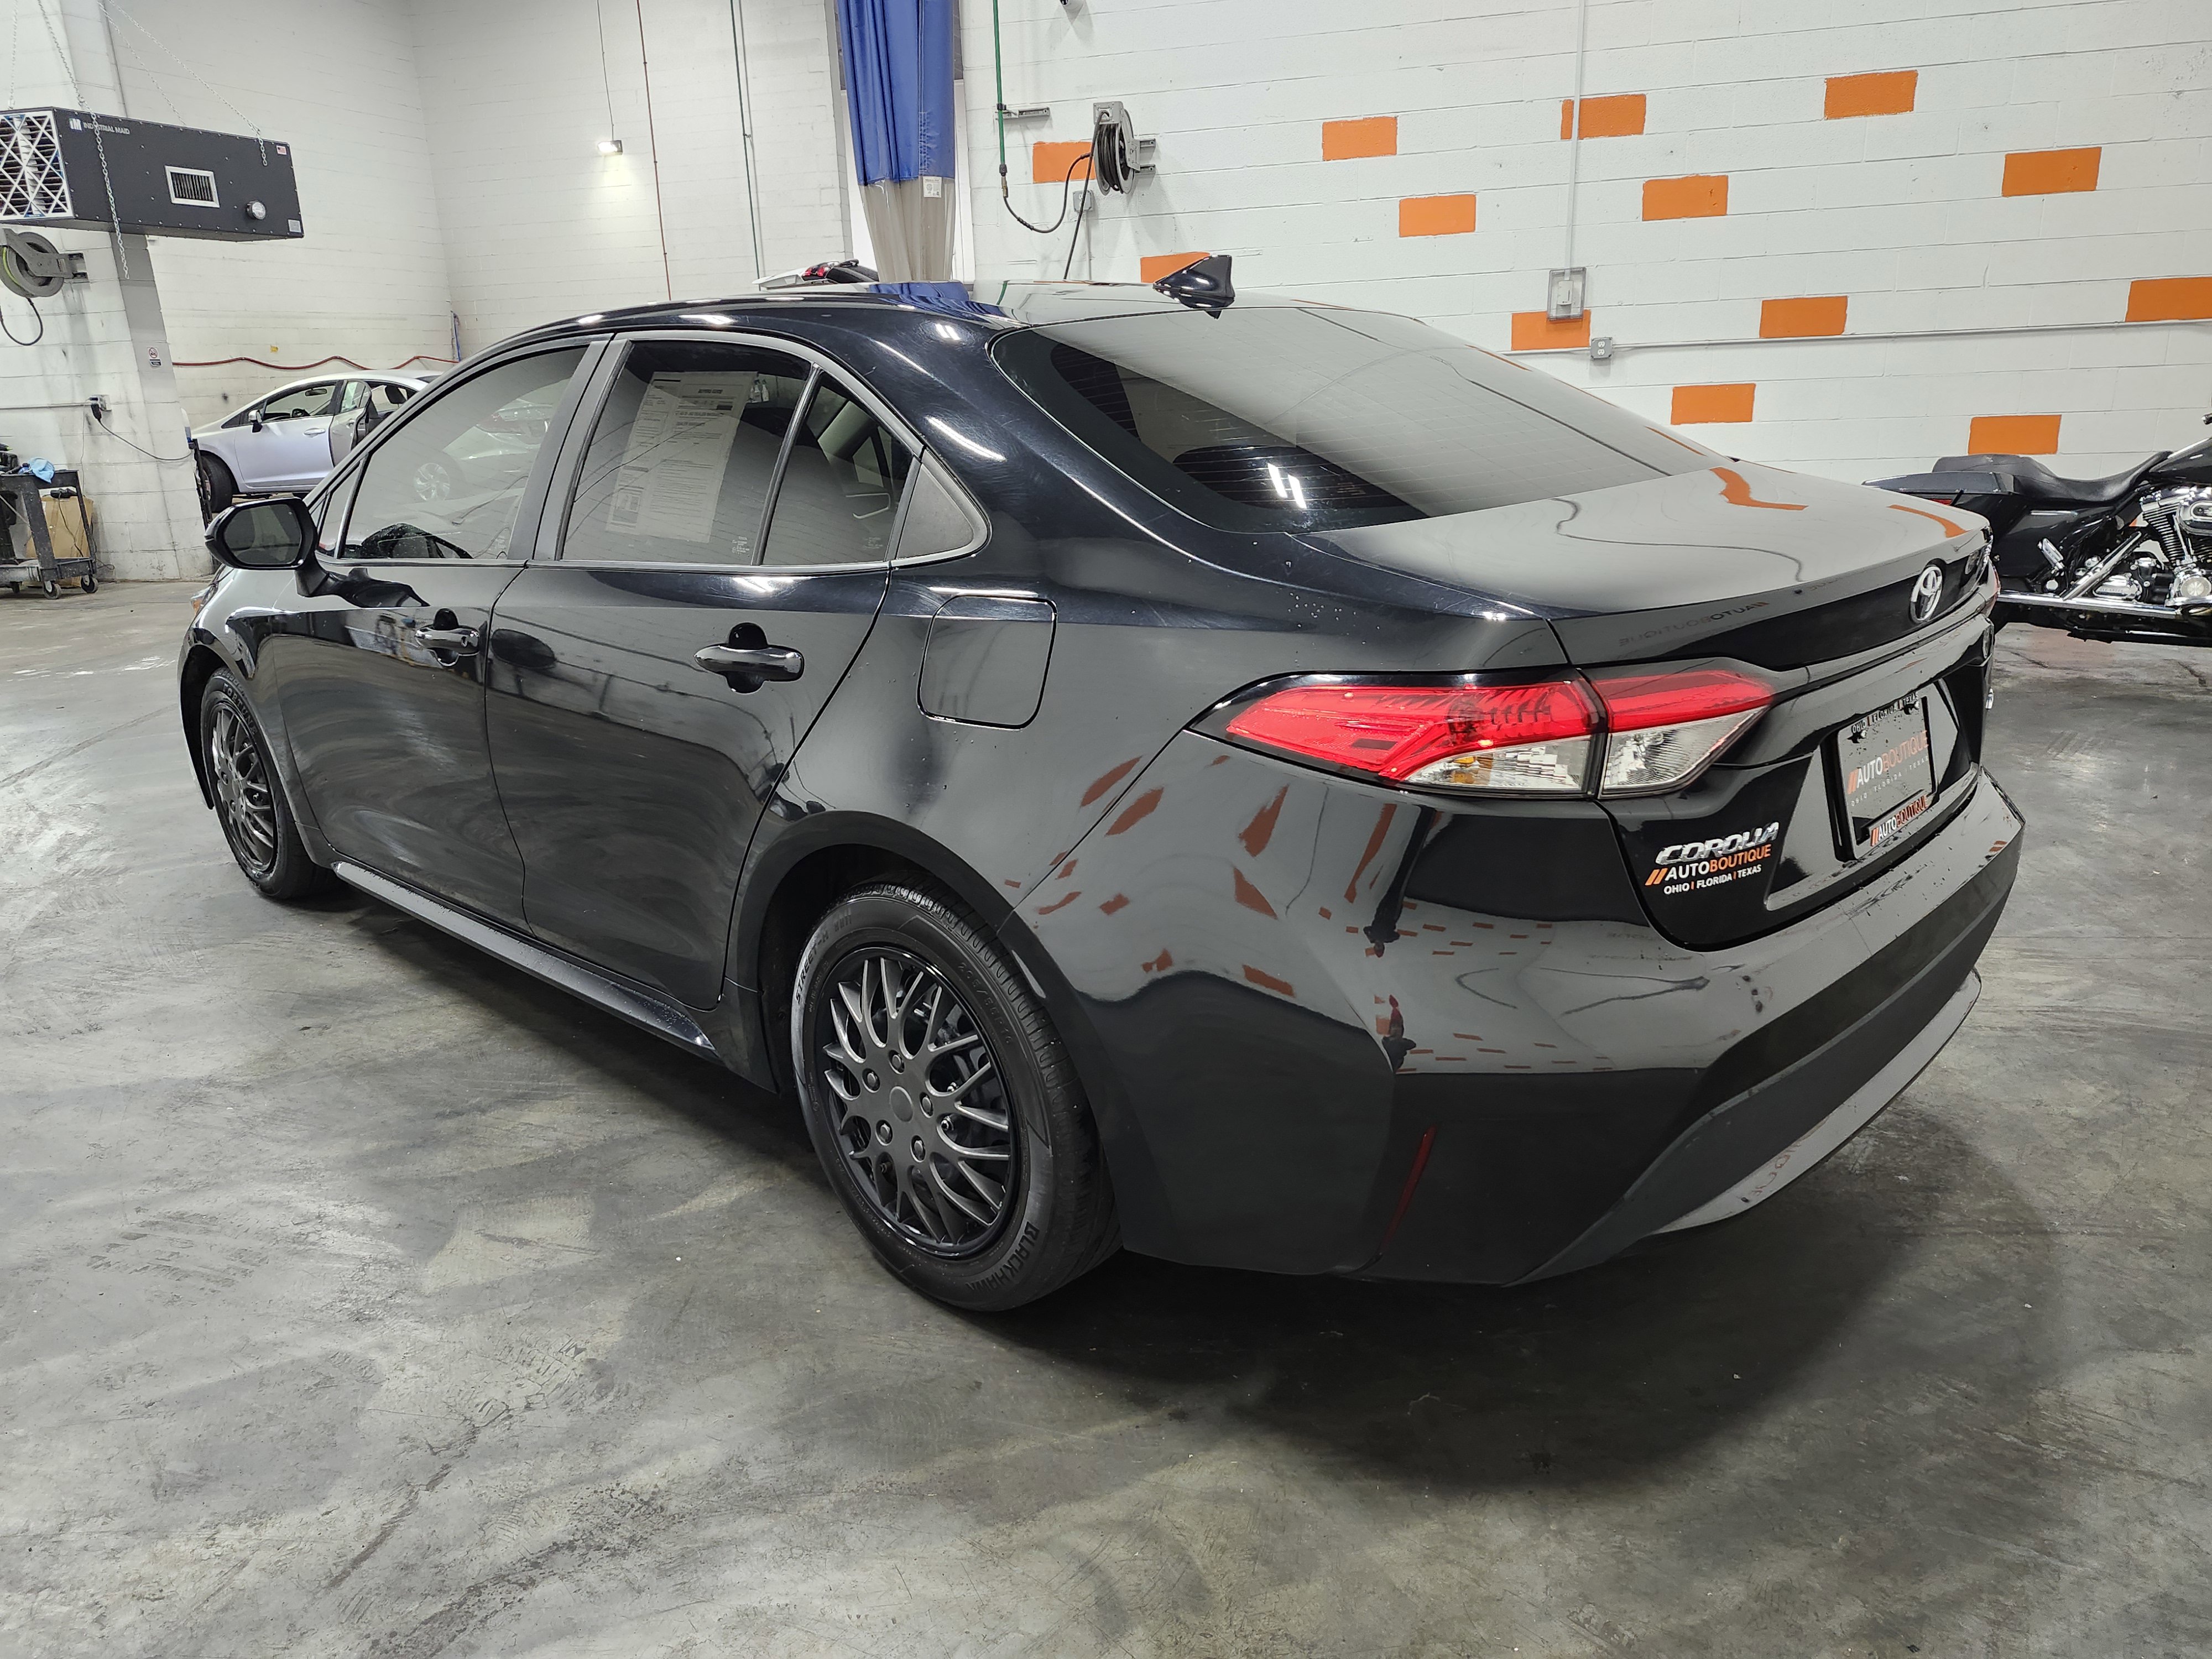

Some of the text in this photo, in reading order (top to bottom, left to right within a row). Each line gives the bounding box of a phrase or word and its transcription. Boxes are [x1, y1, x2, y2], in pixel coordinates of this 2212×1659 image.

[83, 122, 114, 133] INDSTRIAL
[1851, 720, 1866, 733] OHIO
[1903, 691, 1918, 706] TEXAS
[1856, 730, 1929, 788] AUTOBOUTIQUE
[1909, 755, 1929, 770] TEXAS
[1656, 822, 1779, 865] COROLLA
[1663, 864, 1762, 895] OHIO FLORIDA TEXAS
[1665, 844, 1771, 881] AUTOBOUTIQUE
